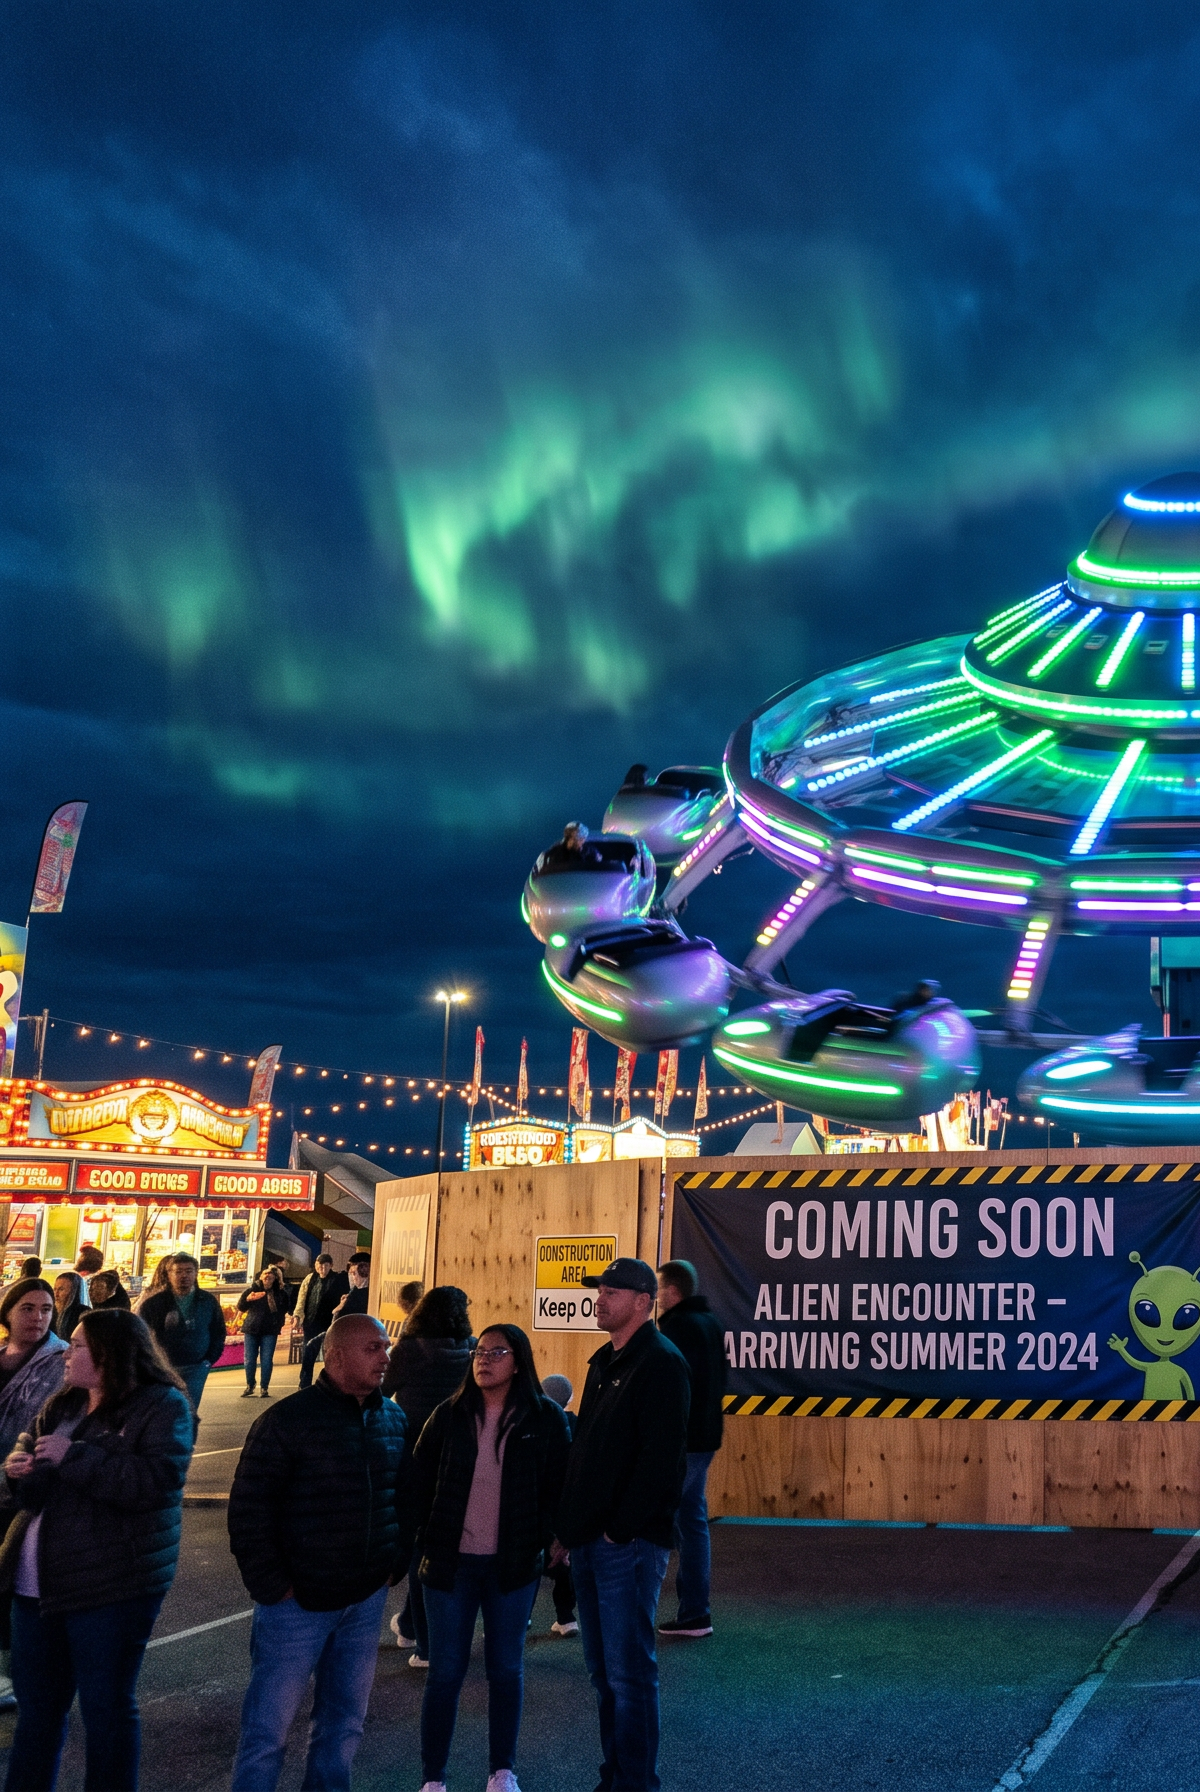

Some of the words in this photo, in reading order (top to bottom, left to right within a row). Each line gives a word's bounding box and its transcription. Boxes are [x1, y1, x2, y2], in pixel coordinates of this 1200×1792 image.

[765, 1199, 959, 1260] COMING
[977, 1197, 1115, 1259] SOON
[539, 1297, 577, 1323] Keep
[754, 1283, 840, 1321] ALIEN
[852, 1282, 1037, 1321] ENCOUNTER
[870, 1331, 1006, 1371] SUMMER
[1017, 1331, 1099, 1371] 2024
